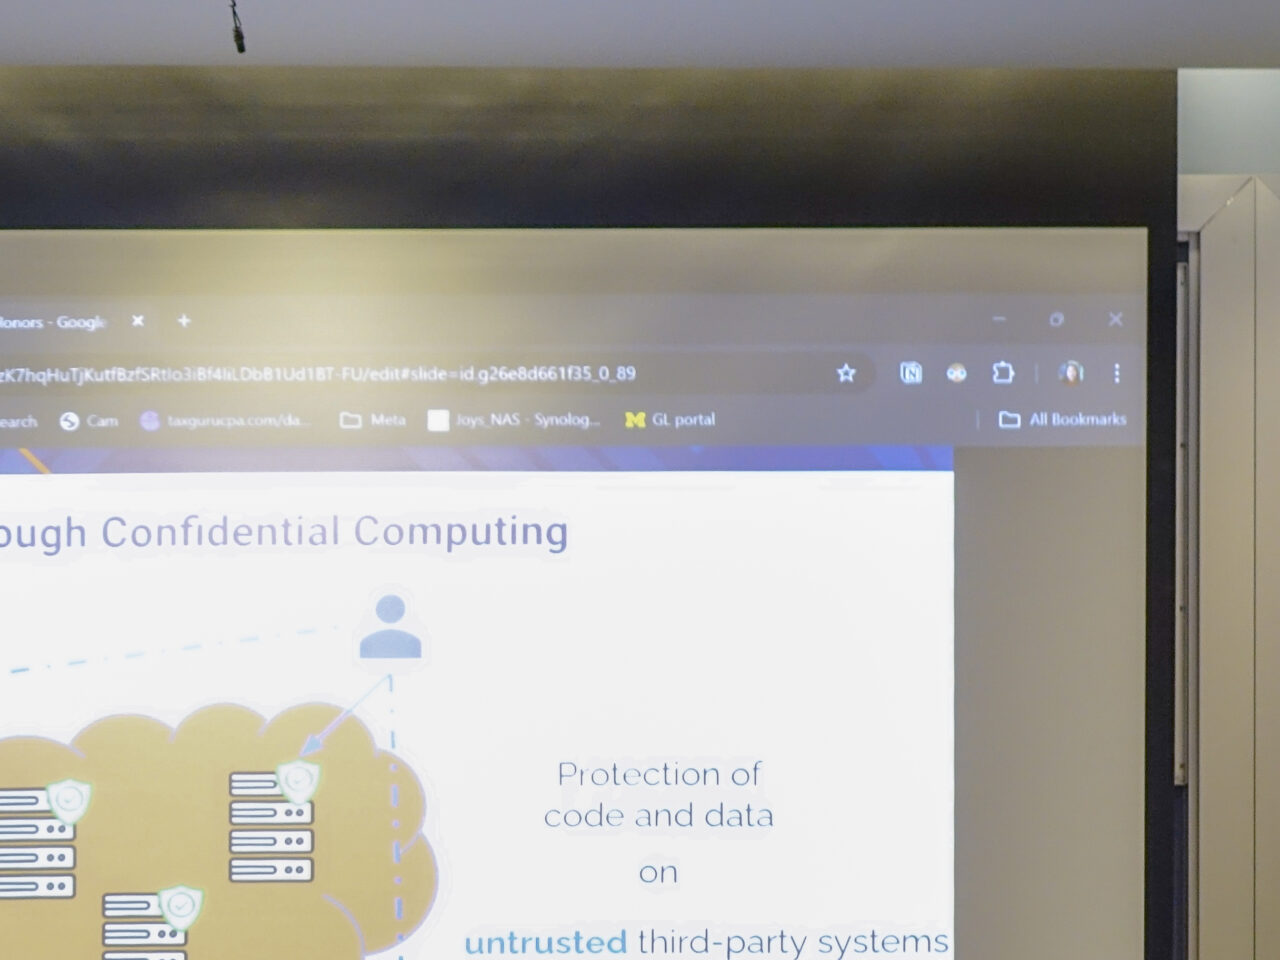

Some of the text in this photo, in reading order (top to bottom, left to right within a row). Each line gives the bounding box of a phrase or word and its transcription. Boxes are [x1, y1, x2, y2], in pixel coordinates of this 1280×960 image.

[86, 414, 119, 428] Cam
[371, 412, 407, 426] Meta
[652, 412, 670, 426] GL
[675, 411, 716, 430] portal
[1029, 412, 1127, 426] All Bookmarks
[101, 514, 340, 551] Confidential
[354, 514, 569, 555] Computing
[557, 760, 764, 787] Protection of
[543, 801, 775, 829] code and data
[638, 862, 678, 884] on
[464, 928, 950, 960] untrusted third-party systems
